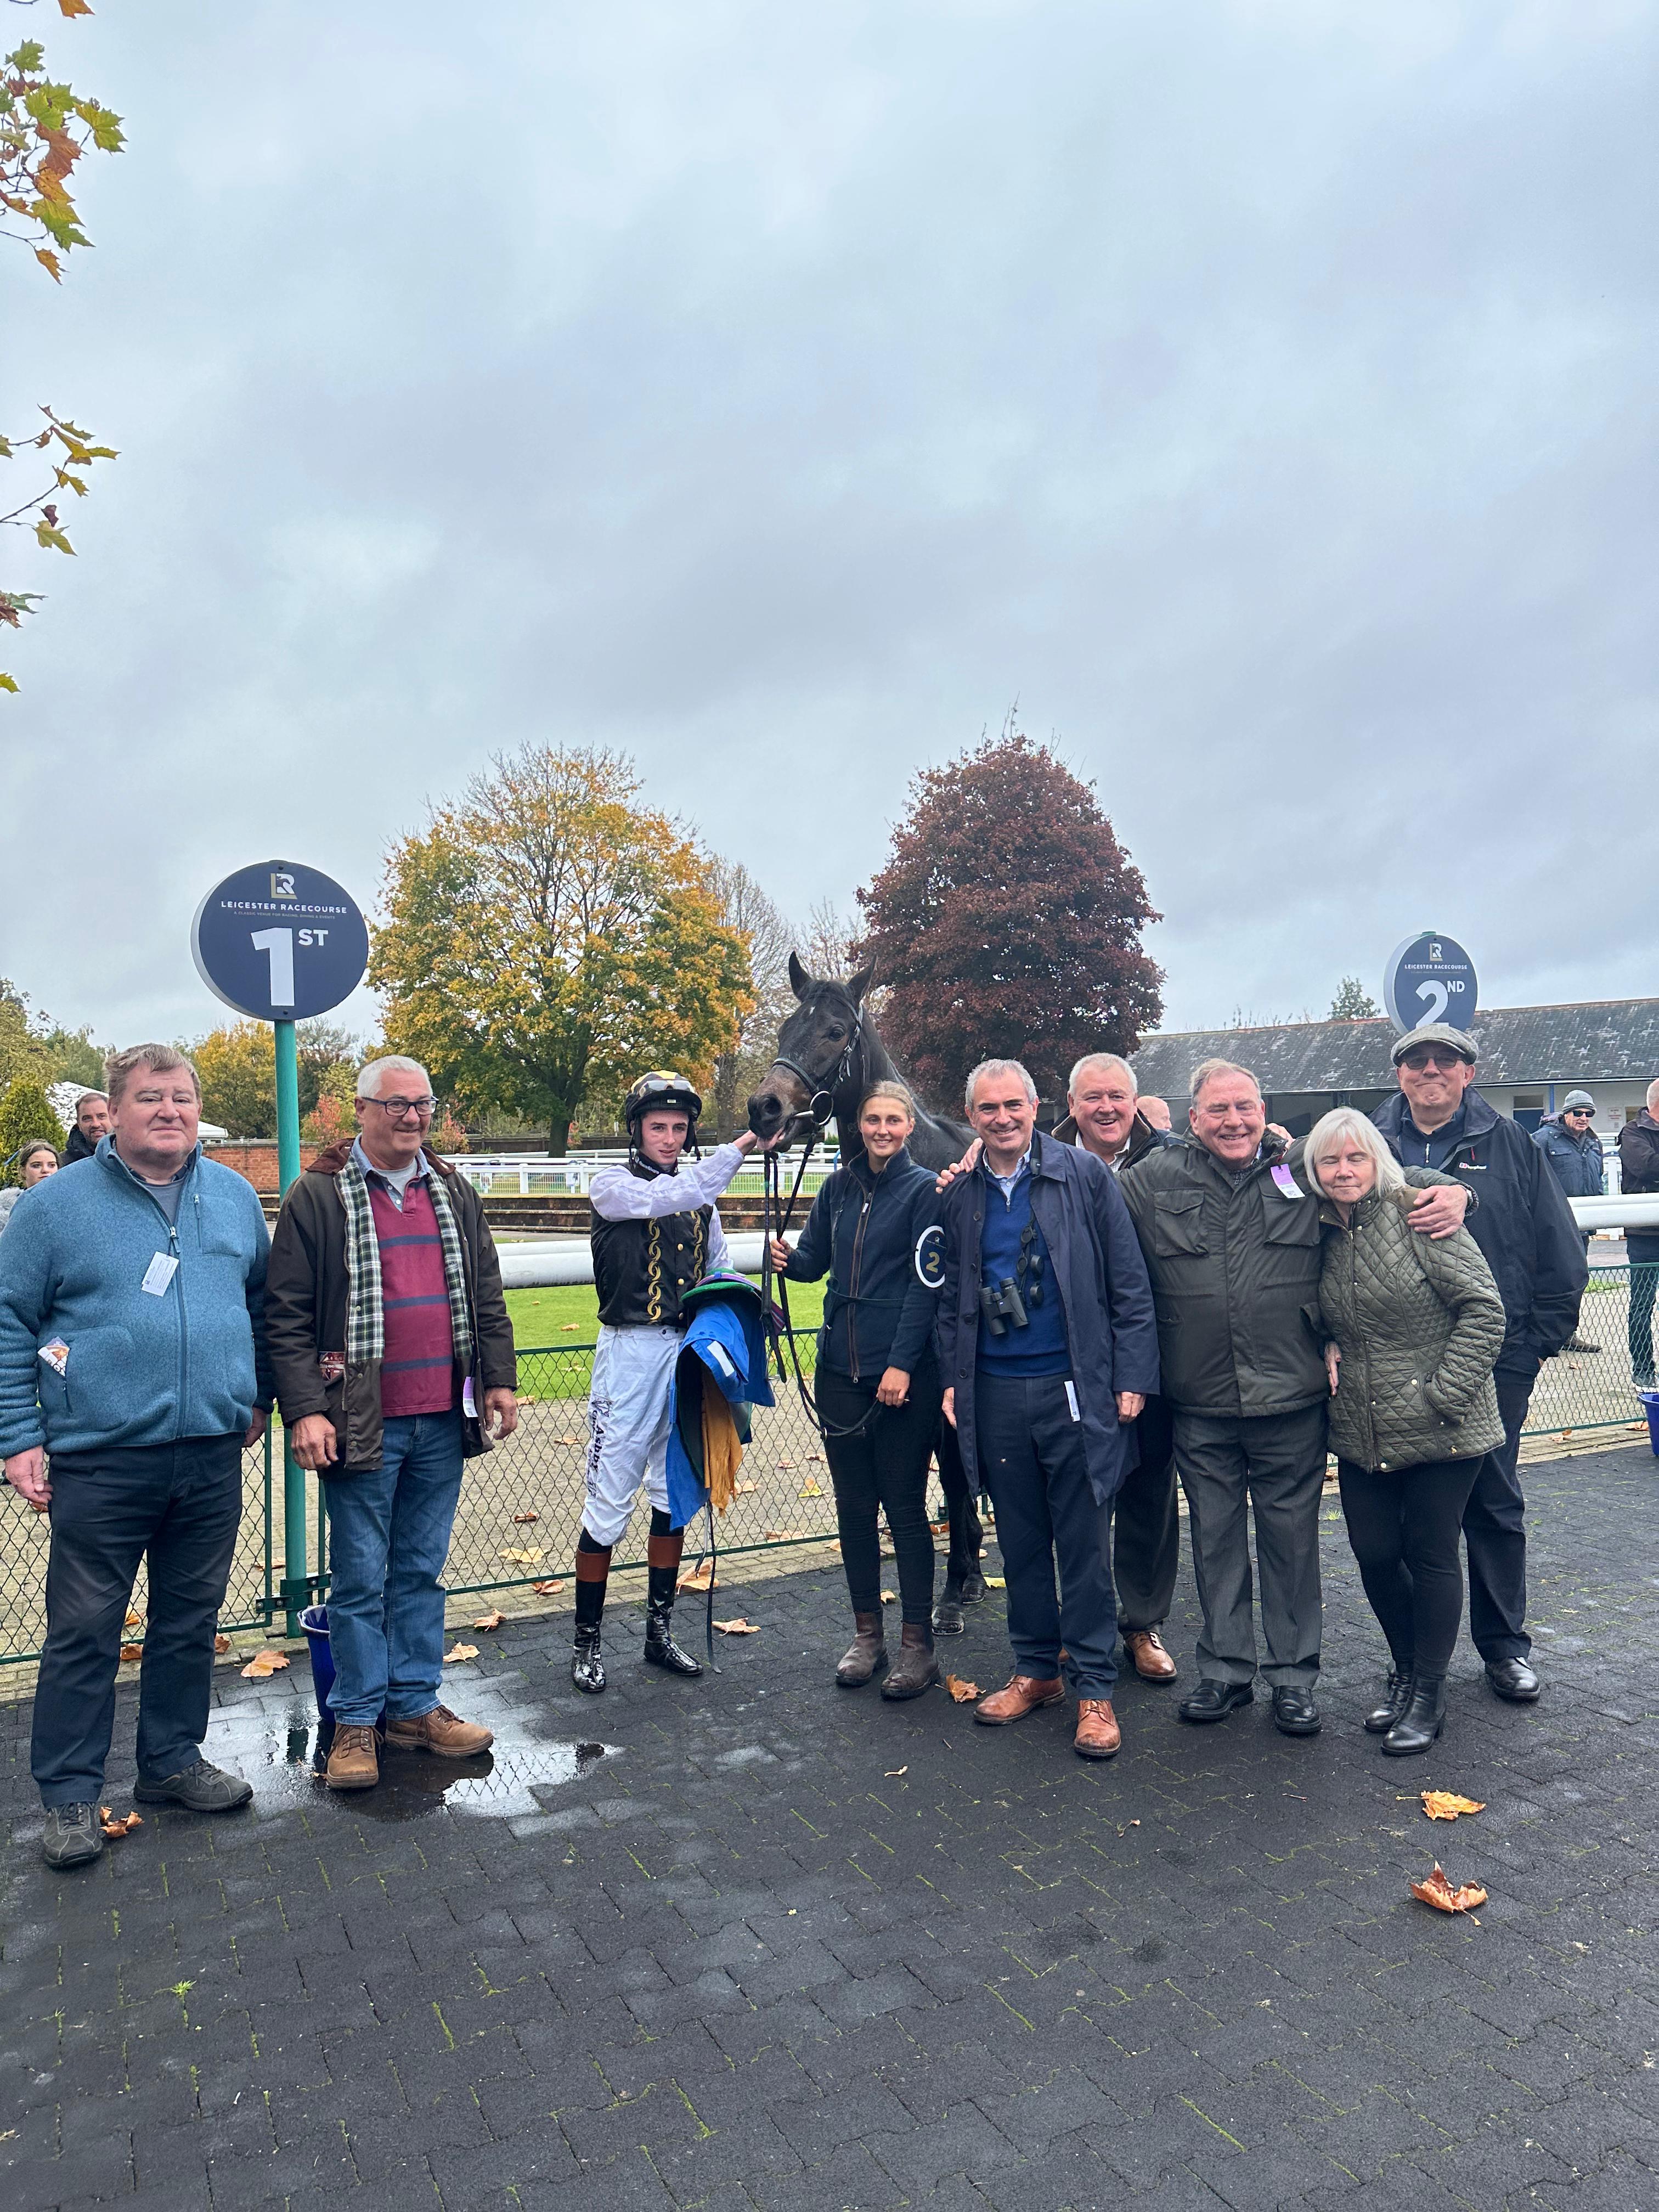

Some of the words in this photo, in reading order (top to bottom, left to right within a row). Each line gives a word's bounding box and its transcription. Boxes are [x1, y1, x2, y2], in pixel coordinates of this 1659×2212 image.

[221, 901, 276, 910] LEICESTER
[280, 904, 347, 913] RACECOURSE
[926, 1251, 940, 1273] 2
[592, 1426, 604, 1473] Ashby
